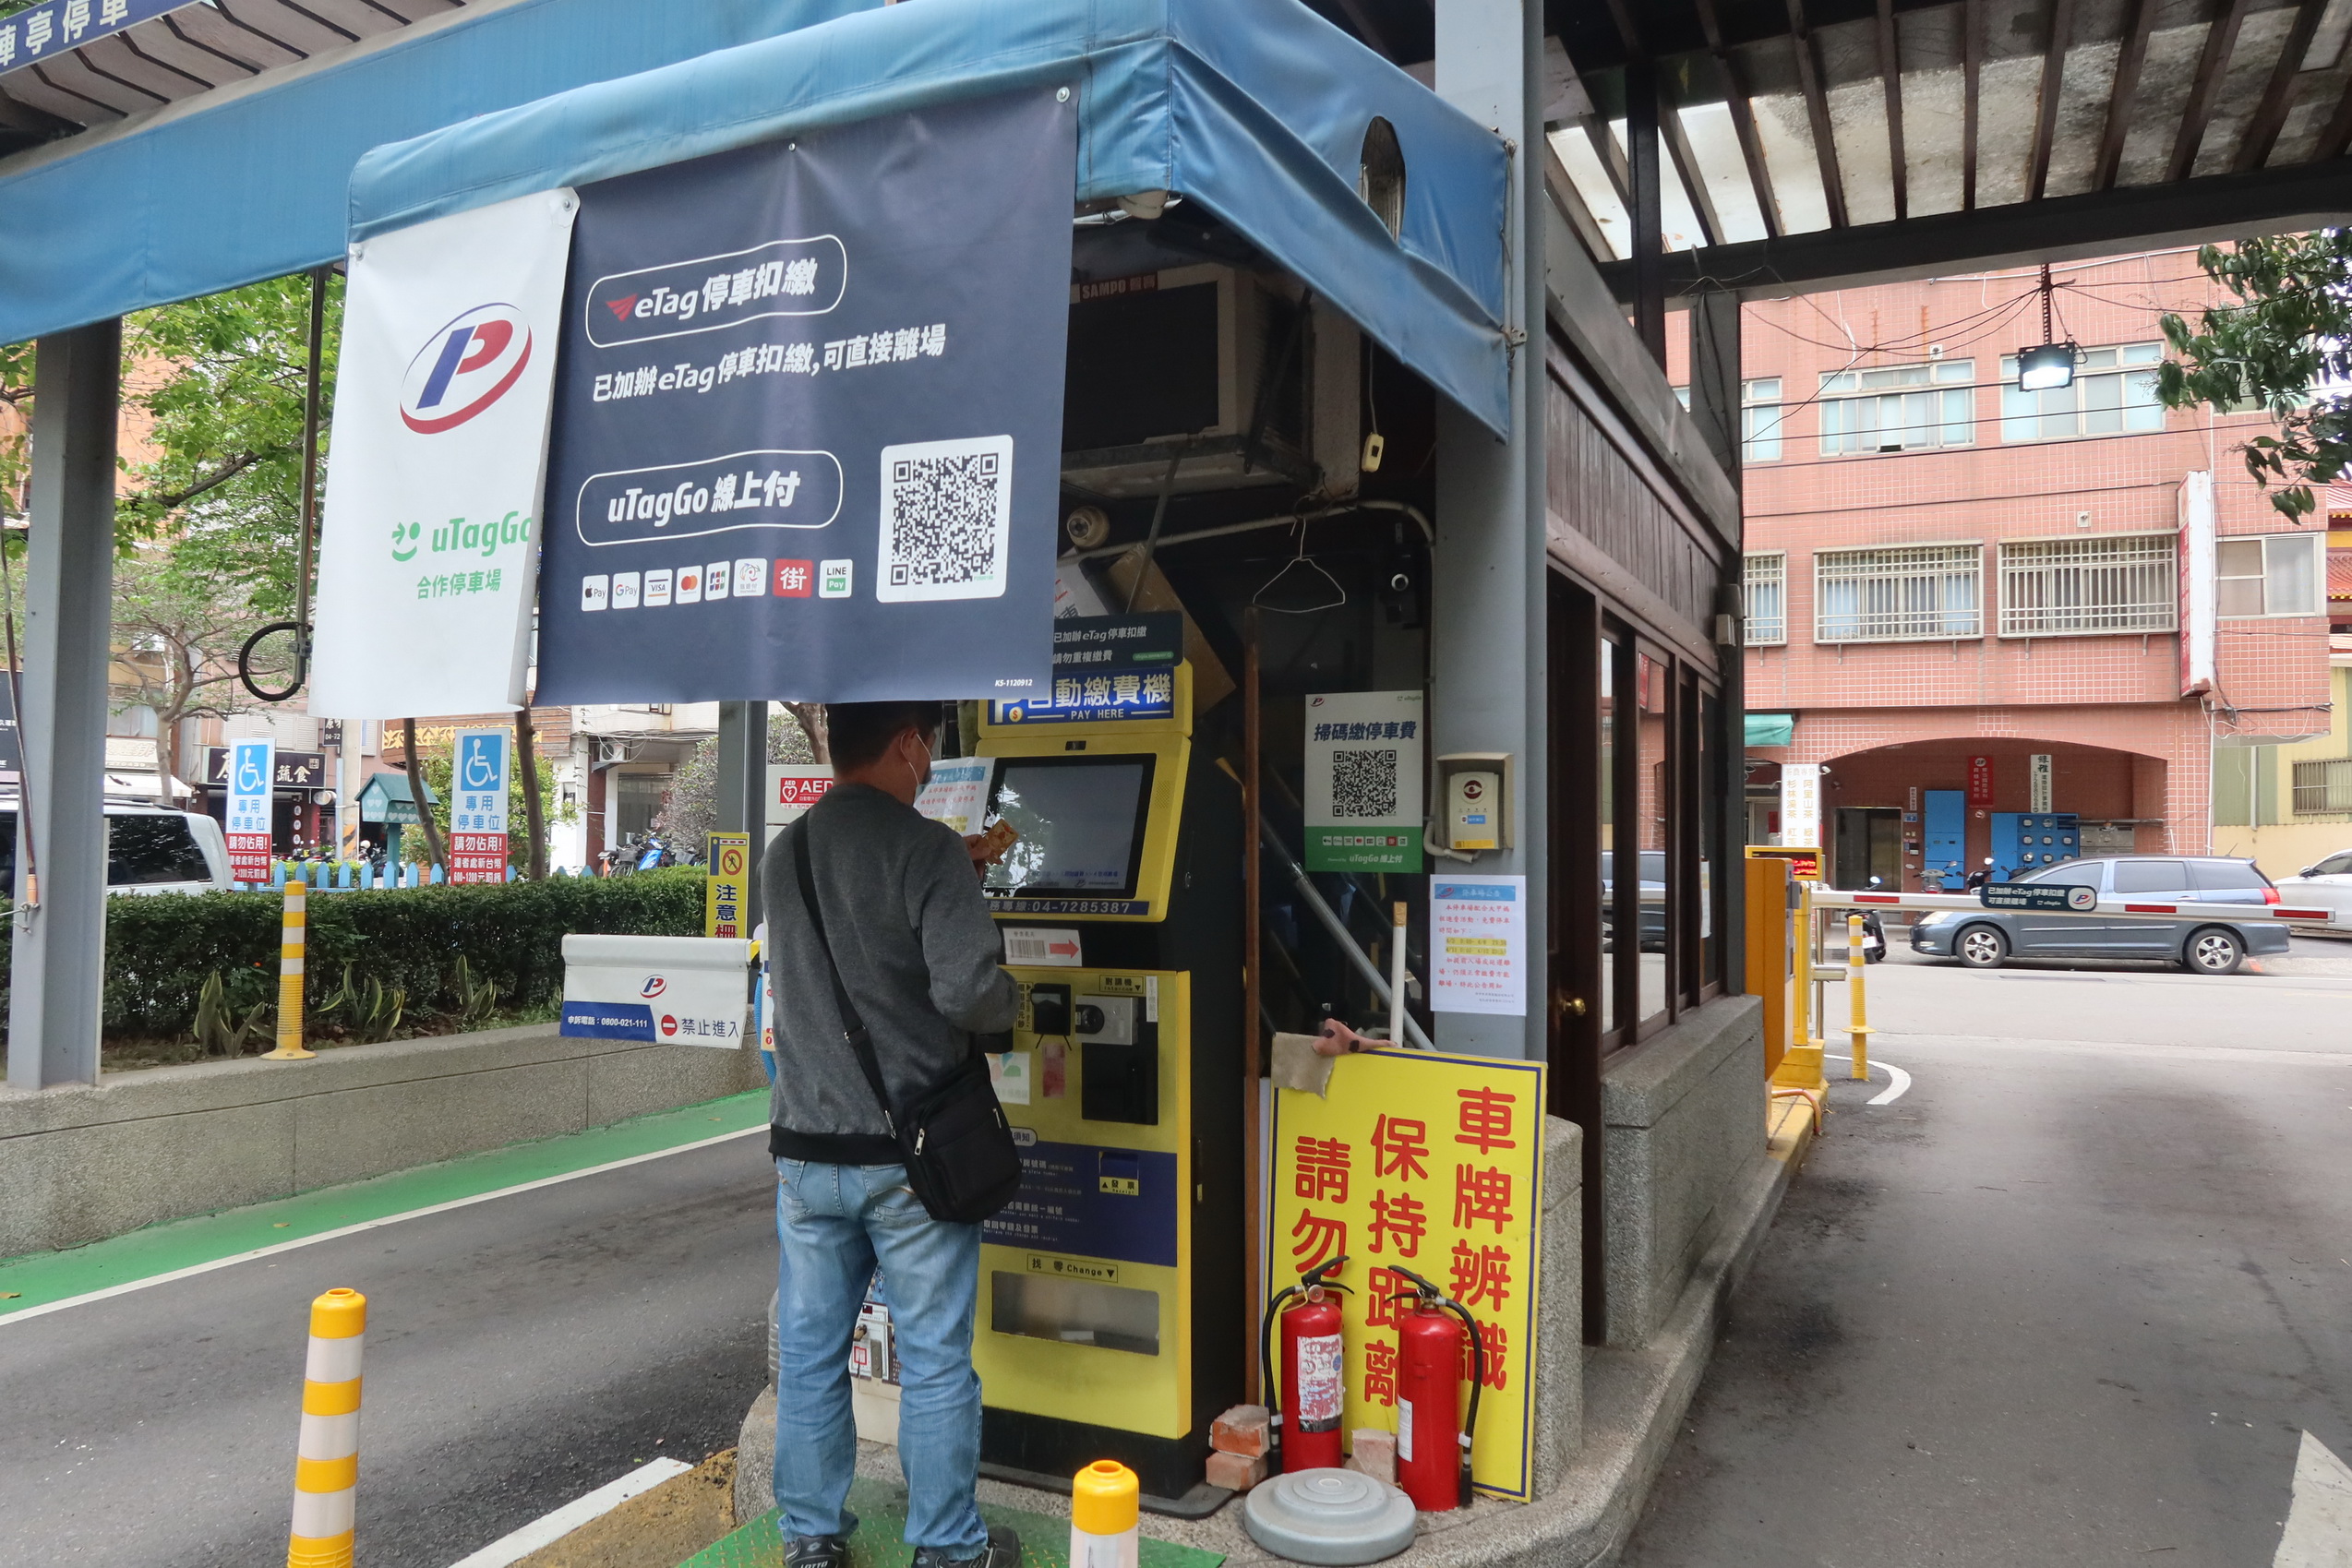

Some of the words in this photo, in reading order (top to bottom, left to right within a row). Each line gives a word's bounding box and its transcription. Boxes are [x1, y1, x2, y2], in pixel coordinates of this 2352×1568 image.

[1082, 279, 1126, 300] SAMPO
[607, 481, 708, 527] uTagGo
[711, 470, 801, 513] 線上付
[827, 567, 847, 577] LINE
[417, 569, 502, 600] 合作停車場
[650, 583, 666, 592] VISA
[828, 581, 845, 590] Pay
[594, 587, 606, 598] Pay
[995, 678, 1033, 688] KS-1120912
[1028, 673, 1171, 710] 動繳費機
[1071, 710, 1090, 720] PAY
[1098, 709, 1124, 719] HERE
[1314, 721, 1417, 742] 掃碼繳停車費
[238, 799, 260, 814] 專用
[465, 796, 494, 811] 專用
[232, 816, 266, 831] 停車位
[458, 814, 500, 830] 停車位
[454, 835, 502, 851] 請勿佔用!
[985, 900, 1130, 914] 務專線:04-7285387
[681, 1018, 739, 1038] 禁止進入
[1452, 1086, 1516, 1392] 車牌辨識
[1067, 1263, 1102, 1276] Change
